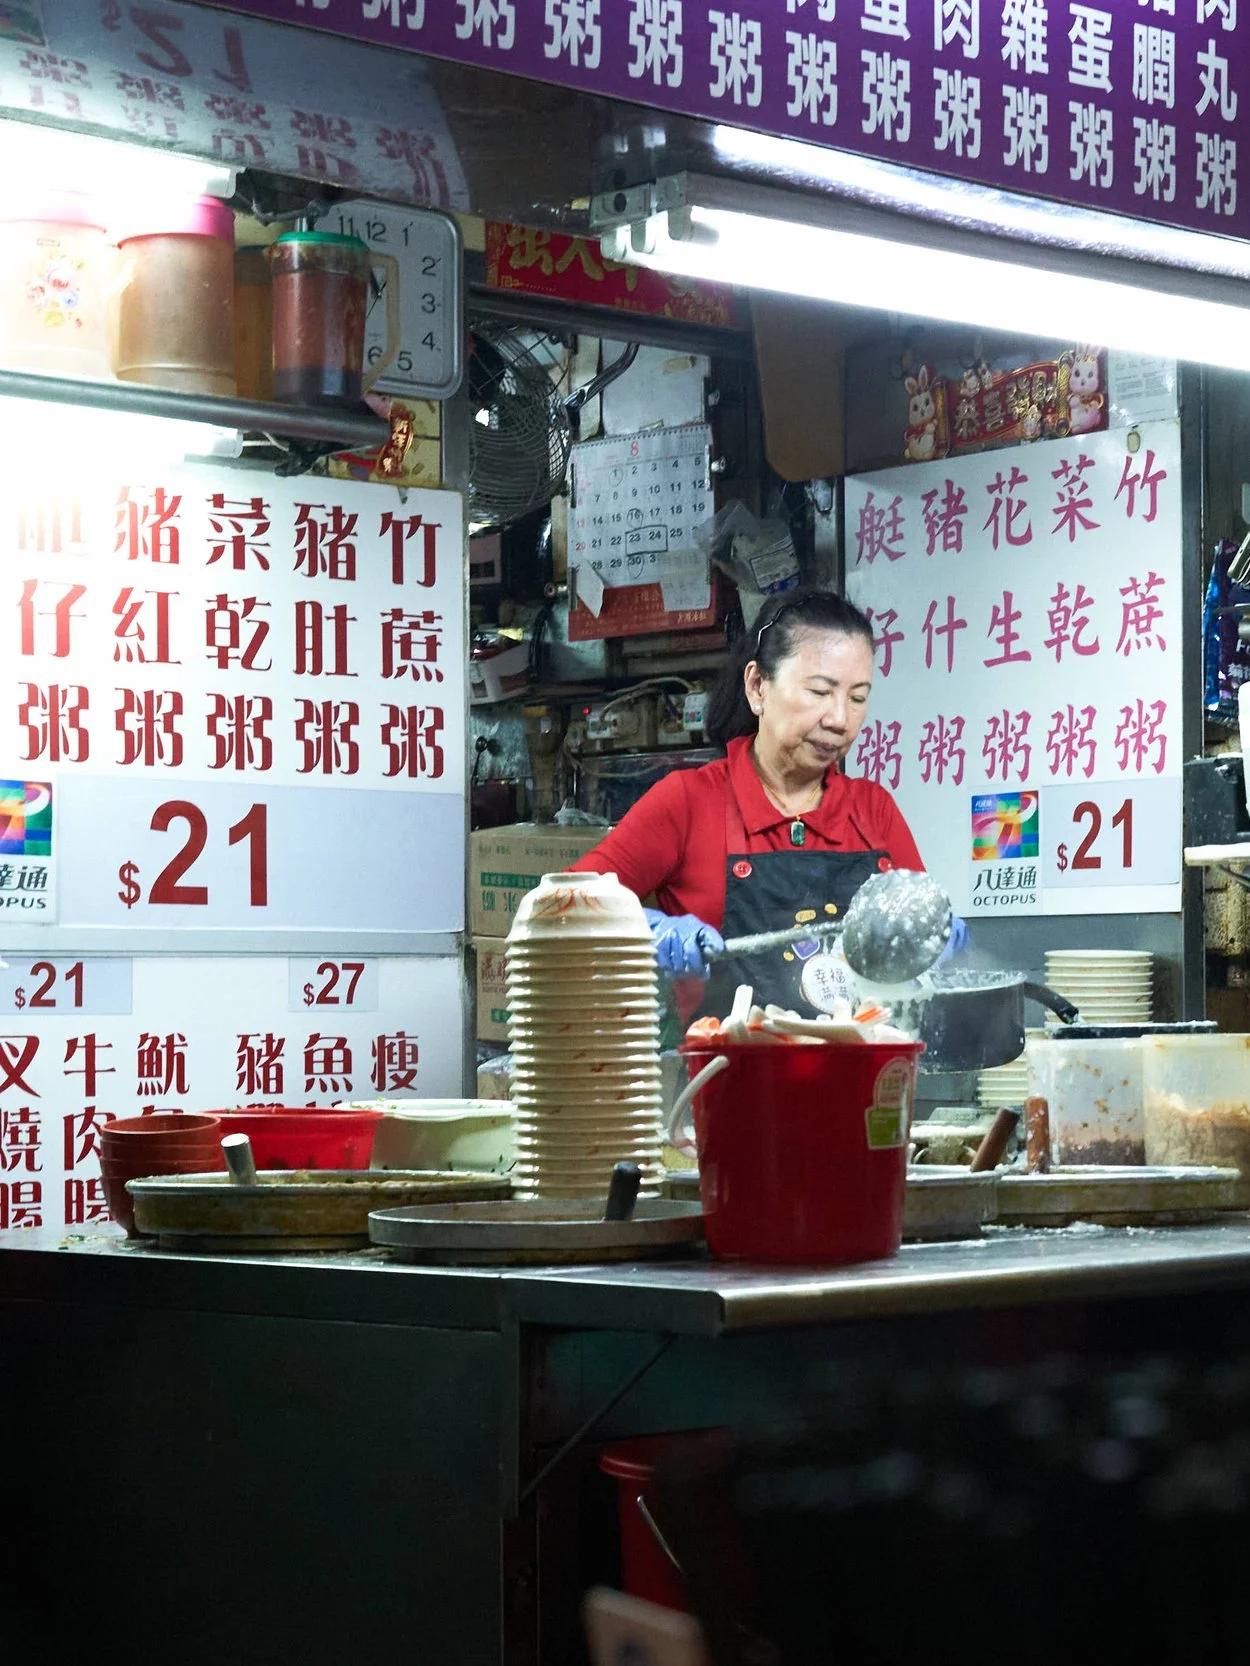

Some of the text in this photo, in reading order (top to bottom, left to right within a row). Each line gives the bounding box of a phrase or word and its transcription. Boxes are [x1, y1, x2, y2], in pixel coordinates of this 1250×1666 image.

[628, 0, 684, 88] 粥
[708, 10, 762, 108] 粥
[786, 0, 839, 126] 粥
[933, 0, 982, 158] 肉粥
[1001, 0, 1049, 174] 雜粥
[1068, 2, 1114, 189] 蛋粥
[1132, 0, 1176, 202] 膶粥
[366, 221, 387, 243] 12
[422, 257, 437, 277] 2
[422, 293, 437, 314] 3
[422, 331, 437, 351] 4
[398, 351, 413, 372] 5
[630, 441, 639, 457] 8
[649, 484, 661, 495] 10
[670, 482, 682, 493] 11
[692, 479, 705, 490] 12
[591, 538, 602, 549] 21
[610, 535, 622, 546] 22
[629, 532, 641, 543] 23
[649, 530, 661, 541] 24
[670, 528, 683, 539] 25
[592, 516, 603, 526] 14
[611, 513, 622, 524] 15
[649, 507, 661, 518] 17
[670, 504, 682, 515] 18
[692, 502, 705, 513] 19
[610, 558, 622, 569] 29
[629, 555, 642, 566] 30
[112, 485, 184, 767] 豬紅粥
[205, 493, 273, 771] 菜乾粥
[293, 502, 360, 775] 豬肚粥
[379, 511, 445, 779] 竹蔗粥
[855, 491, 906, 790] 艇仔粥
[918, 478, 968, 786] 豬什粥
[981, 466, 1033, 785] 花生粥
[1043, 454, 1102, 779] 菜乾粥
[1114, 449, 1169, 775] 竹蔗粥
[118, 799, 268, 909] $21
[973, 865, 1038, 891] 八達通
[1057, 798, 1134, 873] $21
[973, 893, 1037, 907] OCTOPUS
[14, 961, 85, 1010] $21
[303, 961, 366, 1007] $27
[370, 1030, 420, 1092] 瘦
